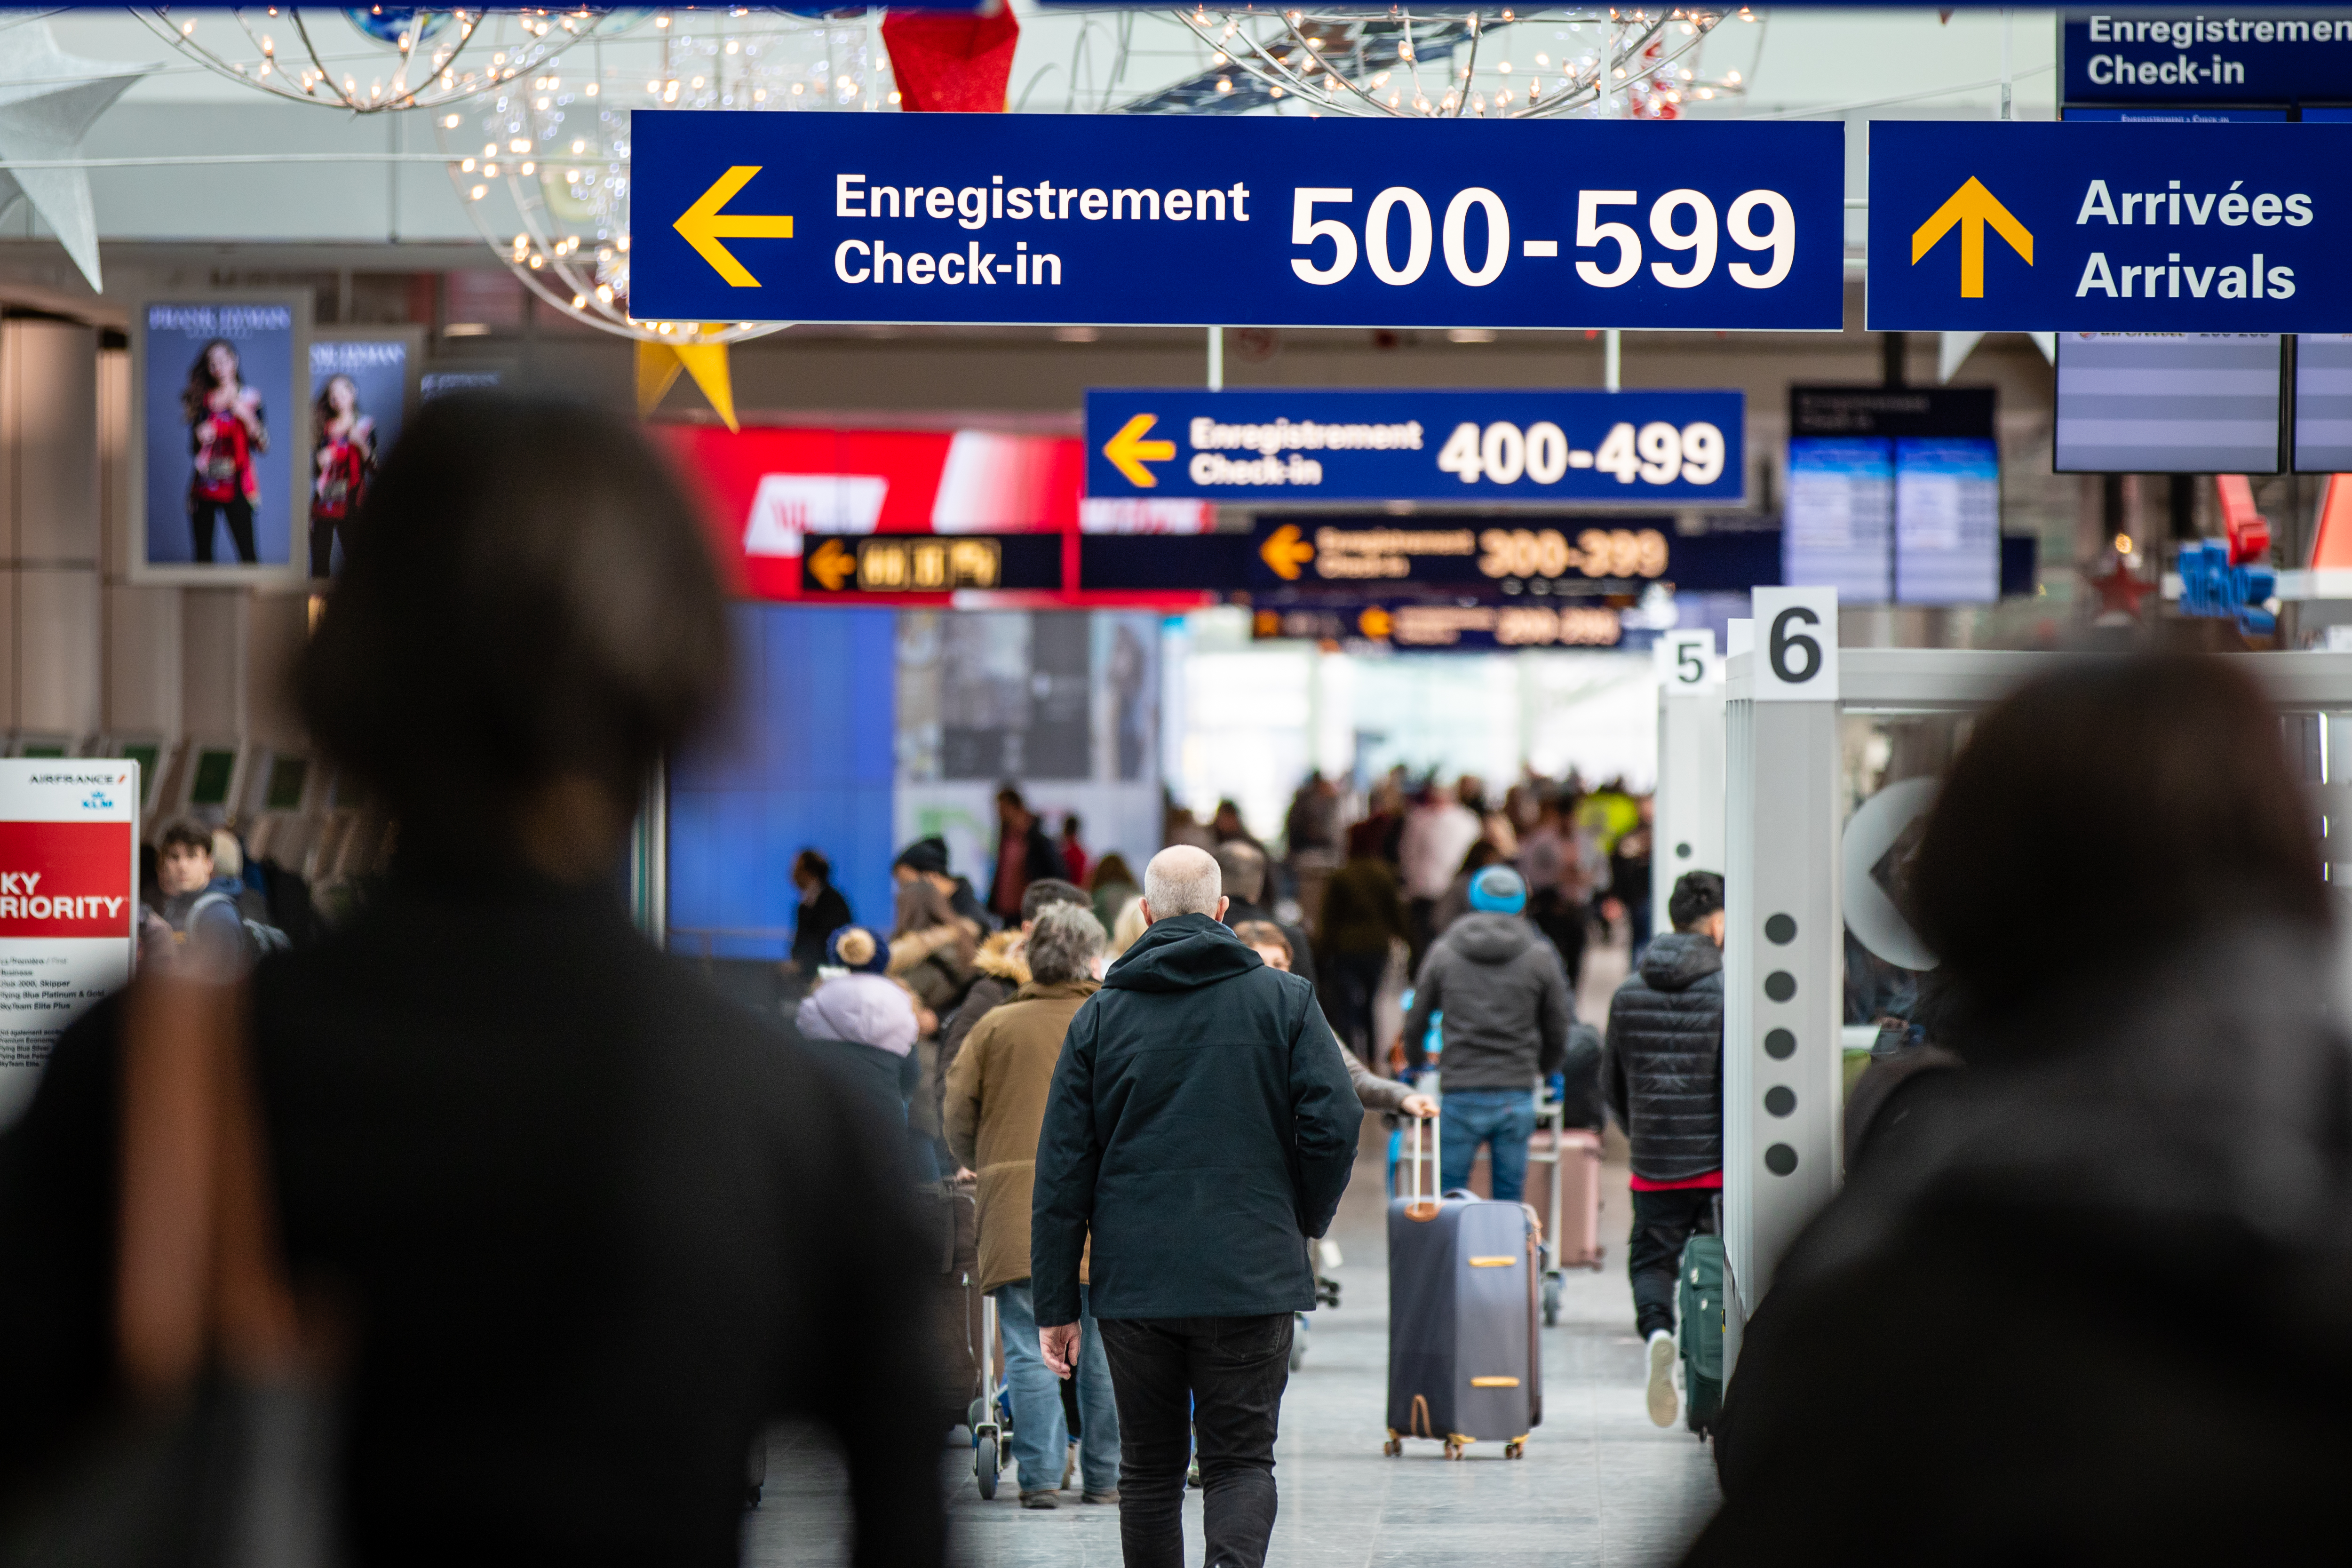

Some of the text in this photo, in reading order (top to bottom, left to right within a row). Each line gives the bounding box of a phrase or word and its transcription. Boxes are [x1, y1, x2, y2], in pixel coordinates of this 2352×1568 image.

[2088, 55, 2244, 84] Check-in
[836, 174, 1250, 230] Enregistrement
[2076, 180, 2313, 227] Arrivées
[1291, 186, 1796, 289] 500-599
[834, 239, 1061, 285] Check-in
[2075, 252, 2296, 299] Arrivals
[1190, 417, 1423, 455] Enregistrement
[1437, 421, 1725, 485] 400-499
[1190, 453, 1322, 486] Check-in
[1479, 529, 1668, 578] 300-399
[1677, 643, 1705, 684] 5
[1770, 606, 1822, 684] 6
[0, 872, 41, 895] KY
[0, 895, 123, 919] RIORITY
[40, 979, 71, 988] Skipper
[41, 990, 76, 999] Platinum
